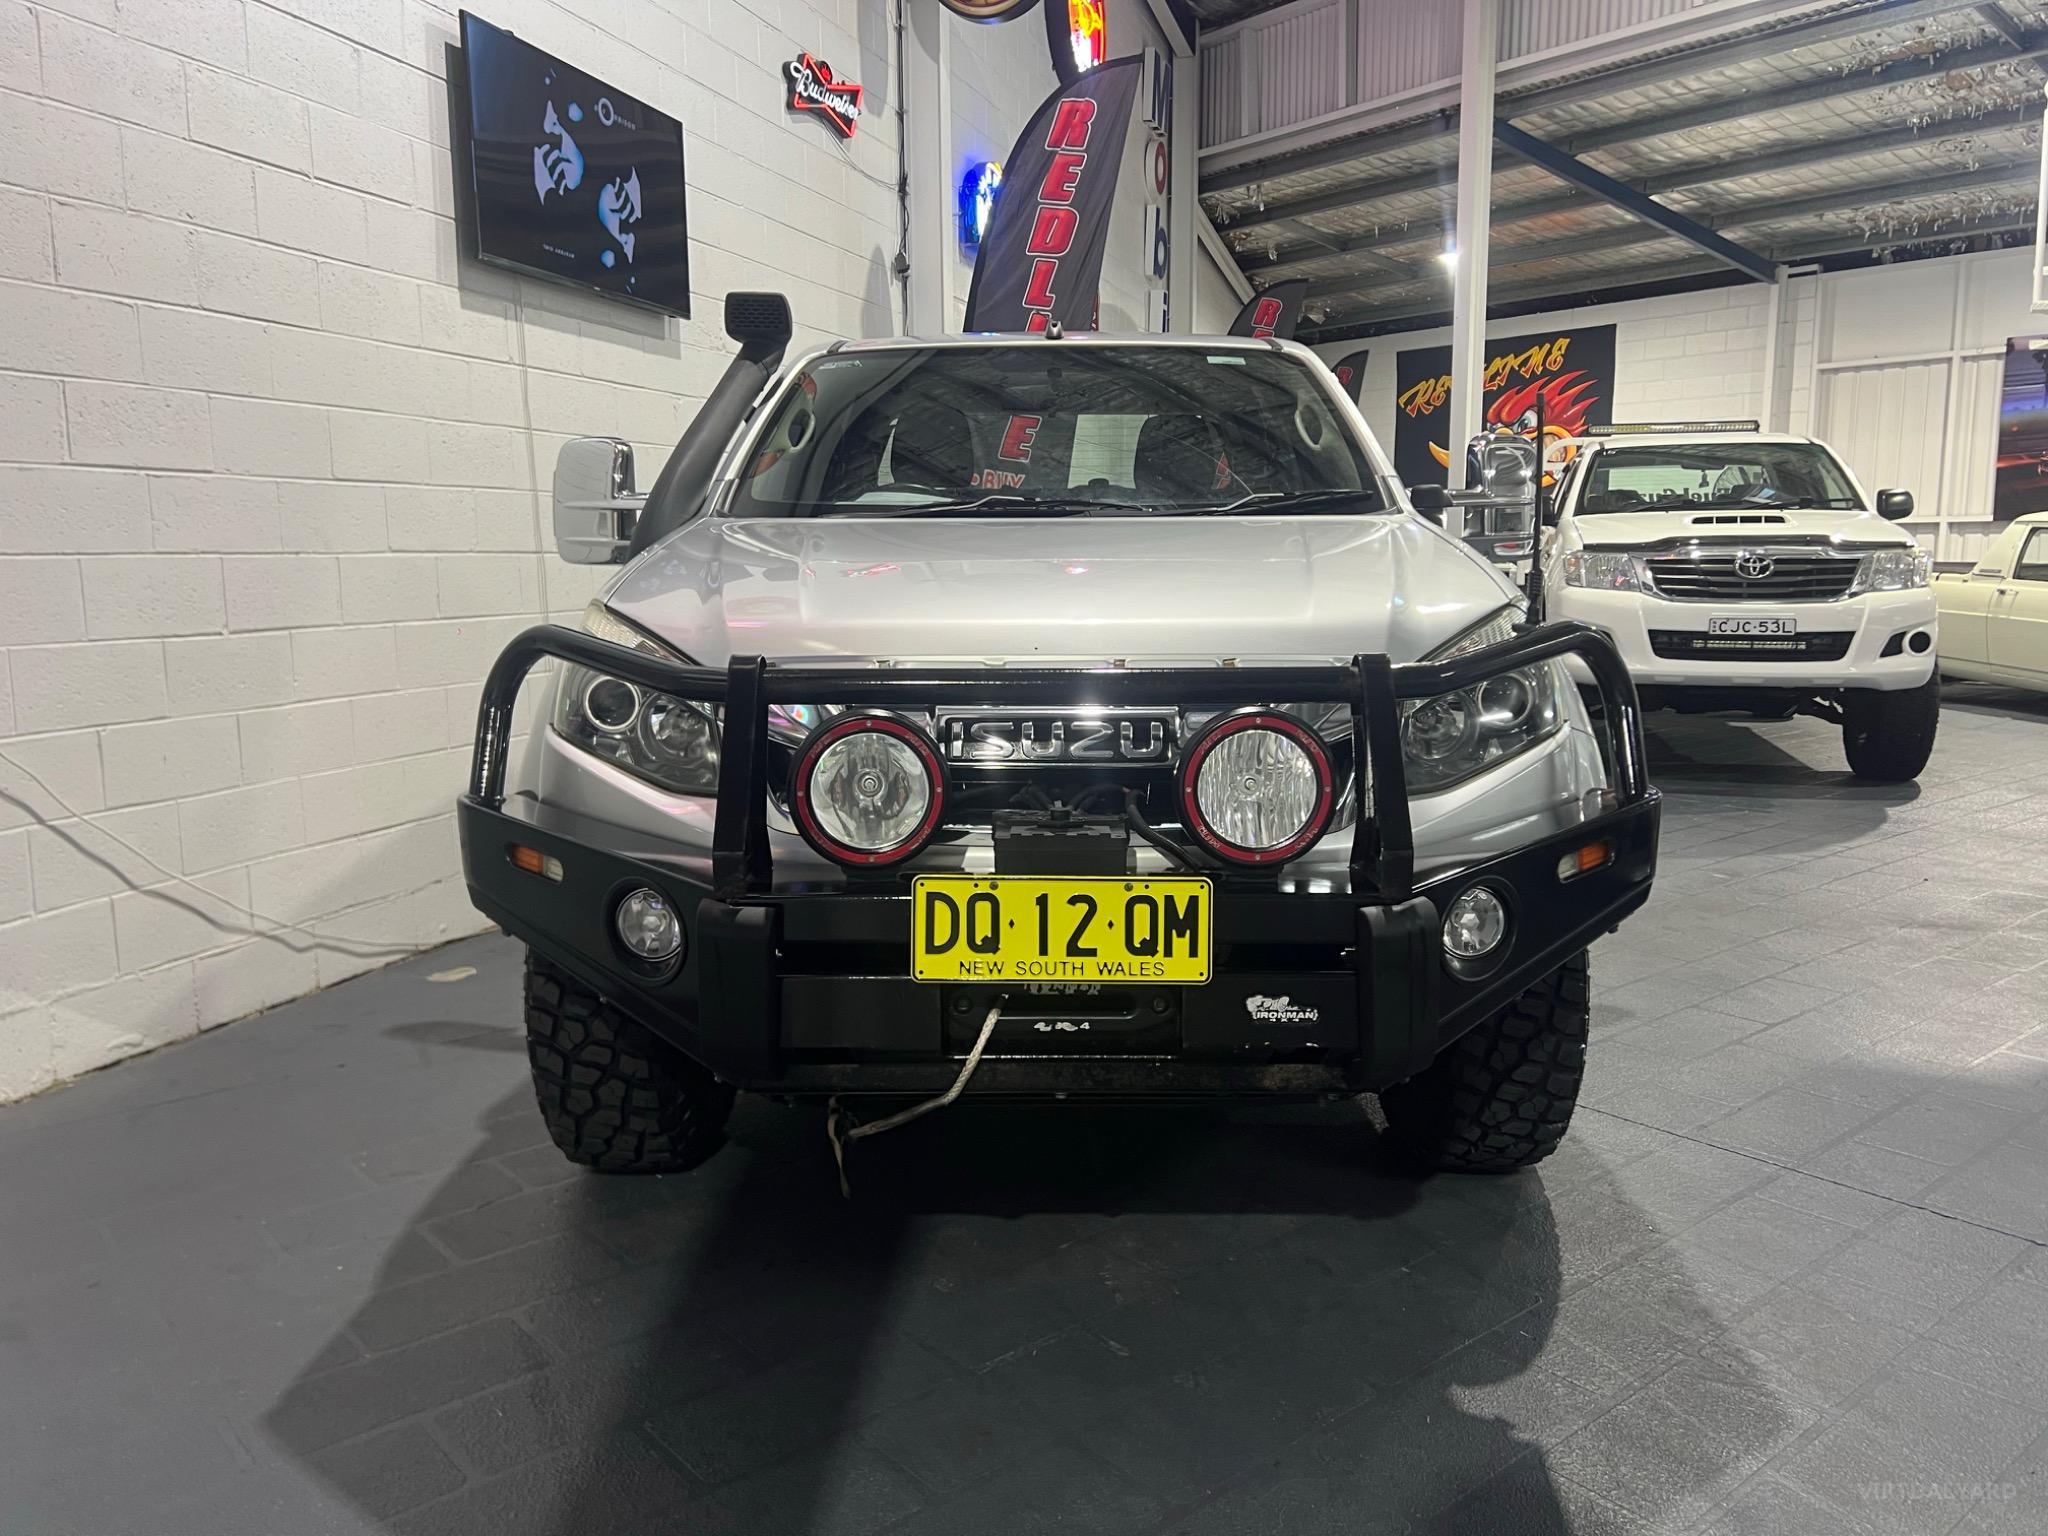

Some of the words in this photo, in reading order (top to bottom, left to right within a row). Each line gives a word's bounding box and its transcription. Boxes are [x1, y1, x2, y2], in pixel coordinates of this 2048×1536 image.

[1398, 338, 1572, 418] RELINE
[952, 721, 1163, 759] ISUZU
[959, 960, 1004, 976] NEW
[1015, 961, 1084, 976] SOUTH
[1096, 961, 1165, 977] WALES
